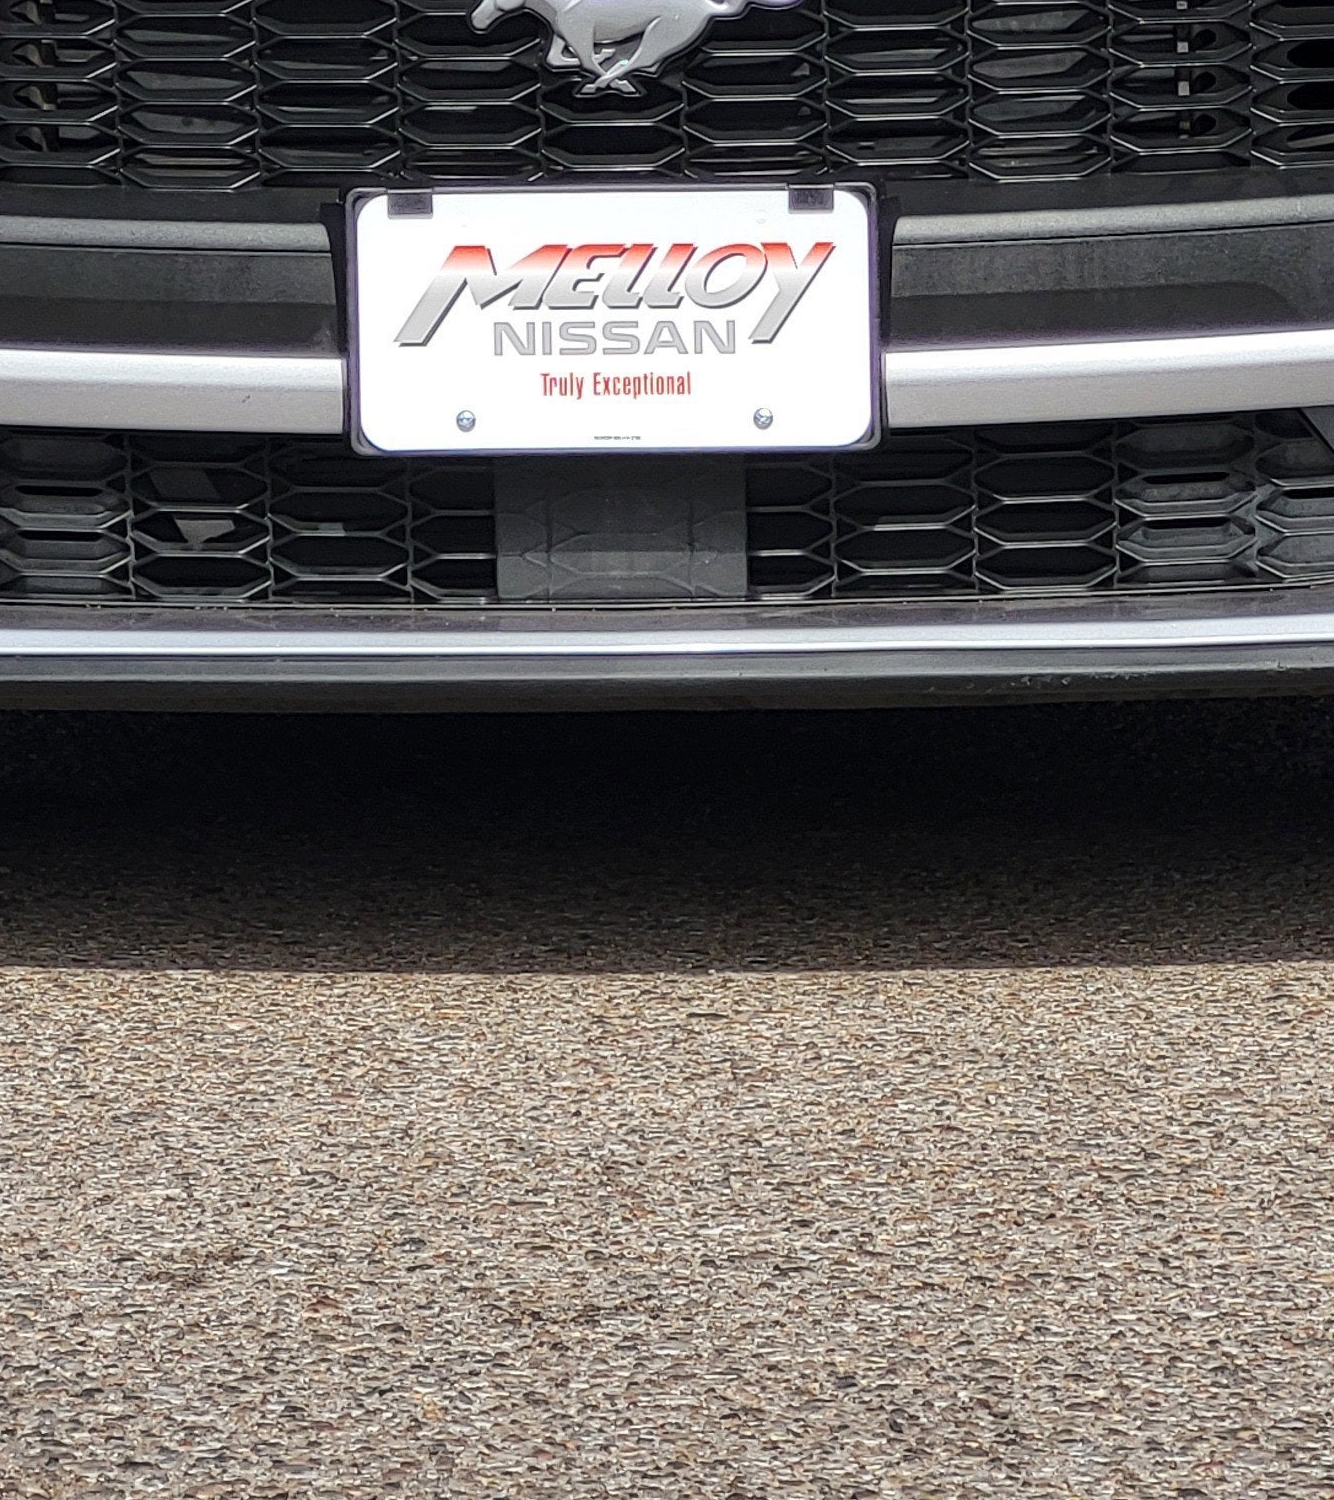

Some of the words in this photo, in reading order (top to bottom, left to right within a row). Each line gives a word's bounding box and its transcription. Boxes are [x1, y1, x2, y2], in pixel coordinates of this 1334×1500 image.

[393, 241, 836, 347] MELLOY
[493, 319, 736, 356] NISSAN
[540, 372, 584, 400] Truly
[593, 371, 692, 400] Exceptional
